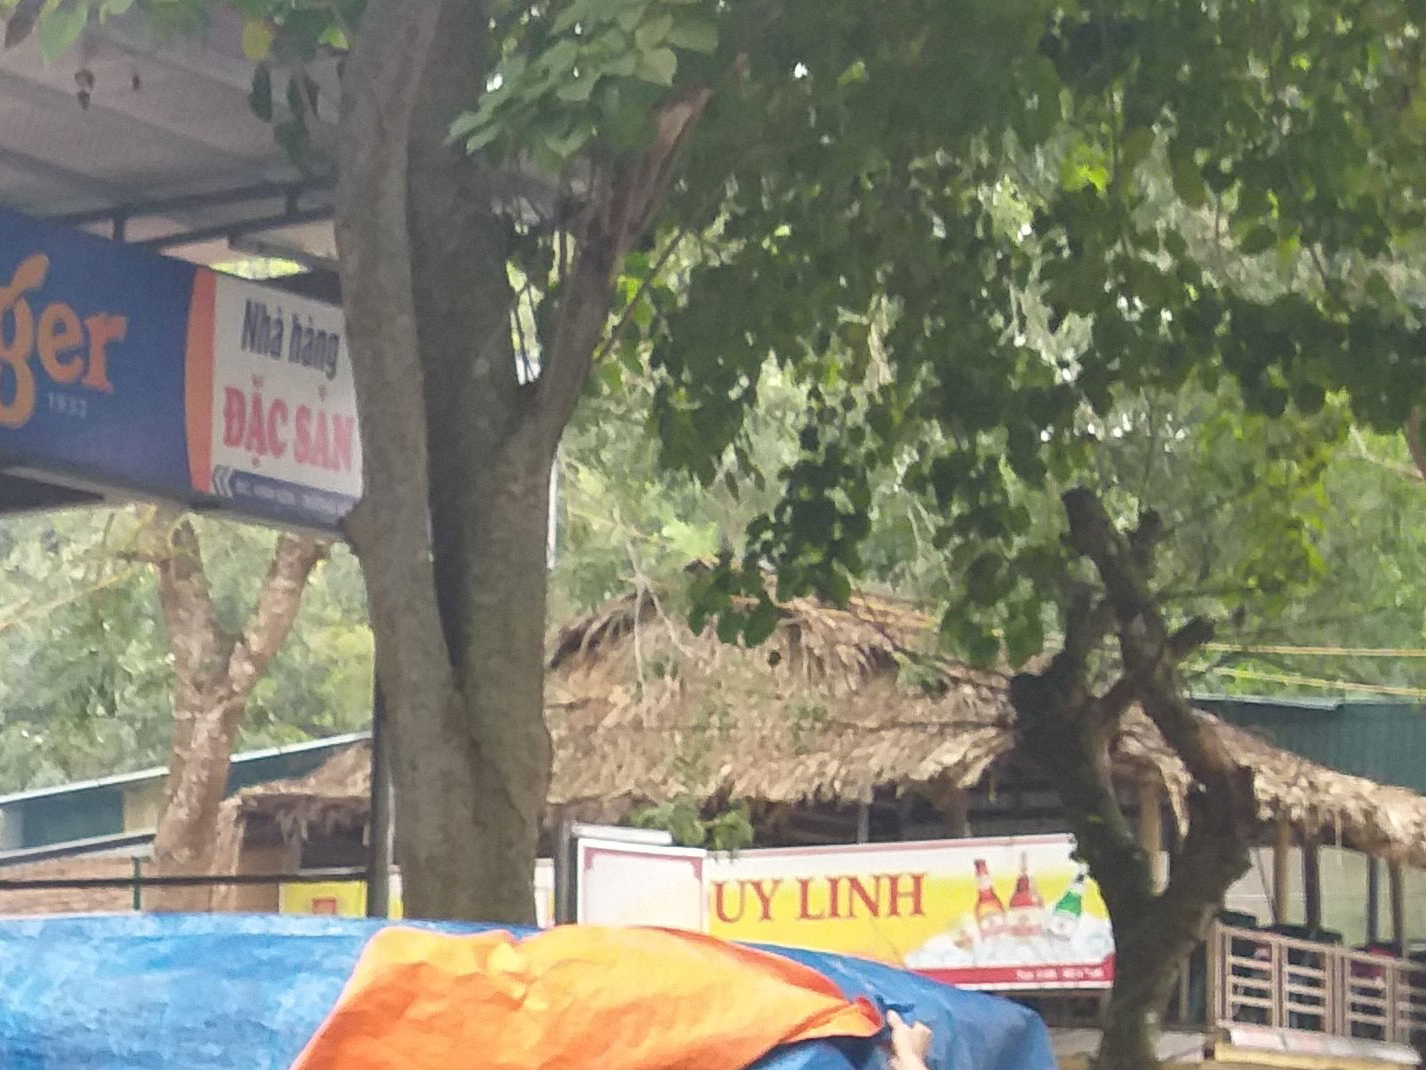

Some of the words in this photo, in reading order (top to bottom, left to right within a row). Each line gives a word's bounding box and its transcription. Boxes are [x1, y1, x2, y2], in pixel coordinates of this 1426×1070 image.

[223, 374, 289, 469] ĐẶC
[708, 877, 785, 924] UY
[795, 870, 928, 921] LINH
